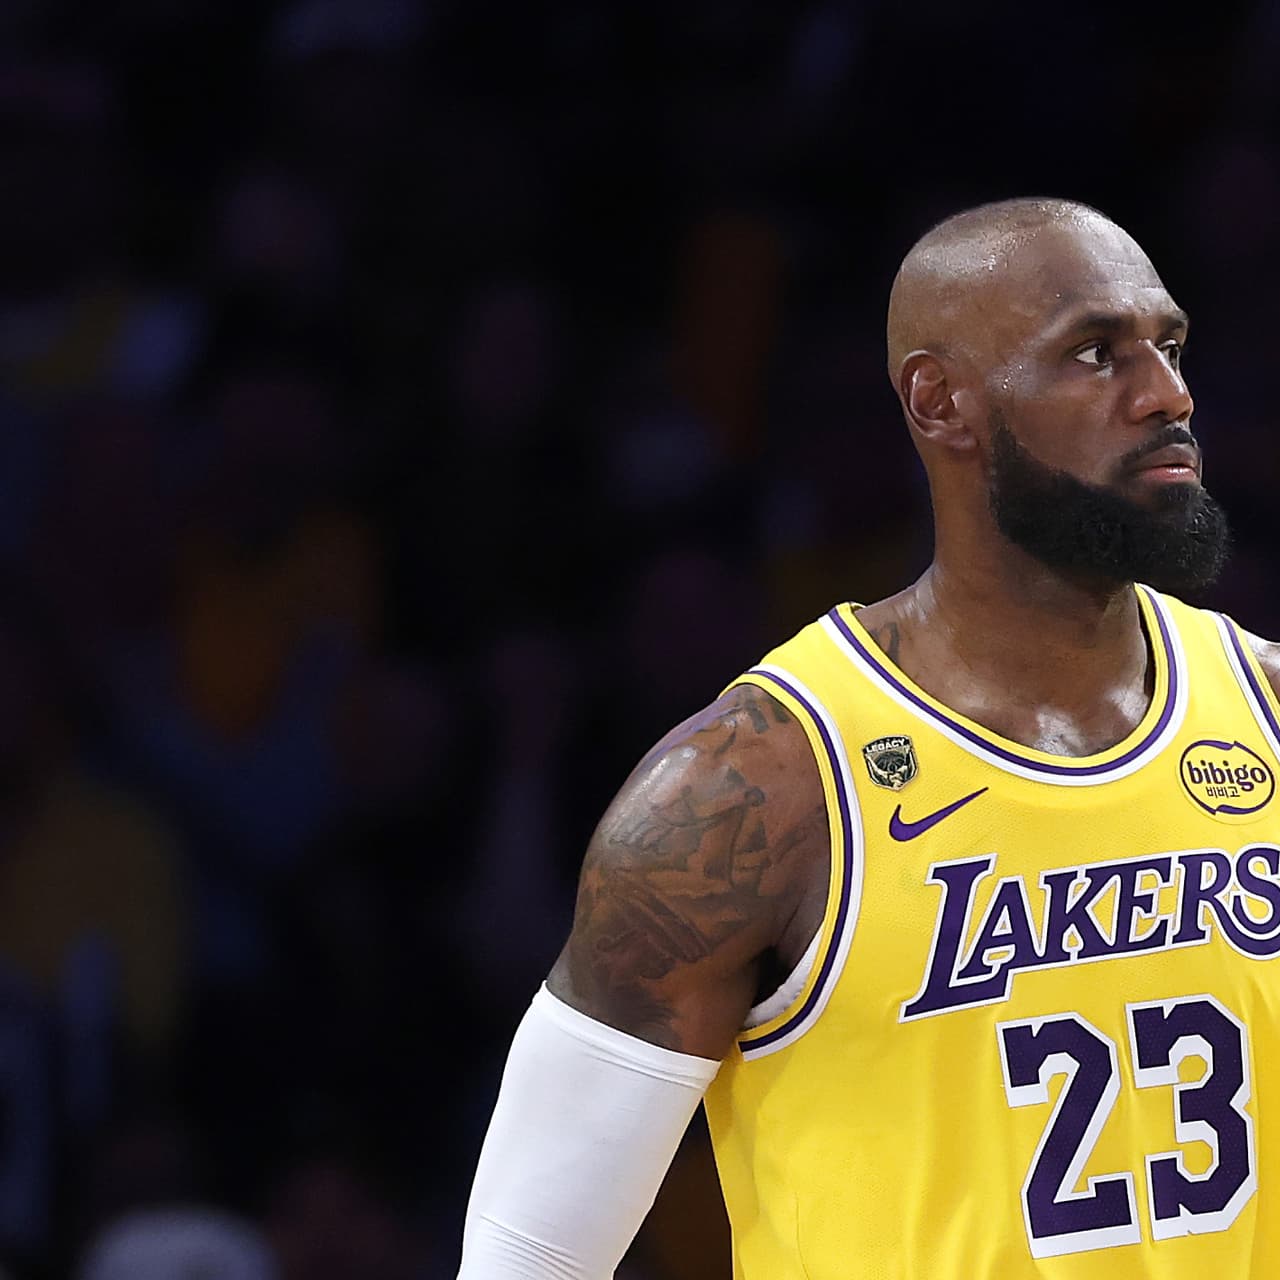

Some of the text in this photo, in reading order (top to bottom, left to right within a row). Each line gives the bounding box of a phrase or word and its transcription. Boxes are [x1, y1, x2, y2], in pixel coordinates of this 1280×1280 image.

[866, 738, 905, 753] LEGACY
[1186, 759, 1267, 792] bibigo
[996, 993, 1258, 1259] 23
